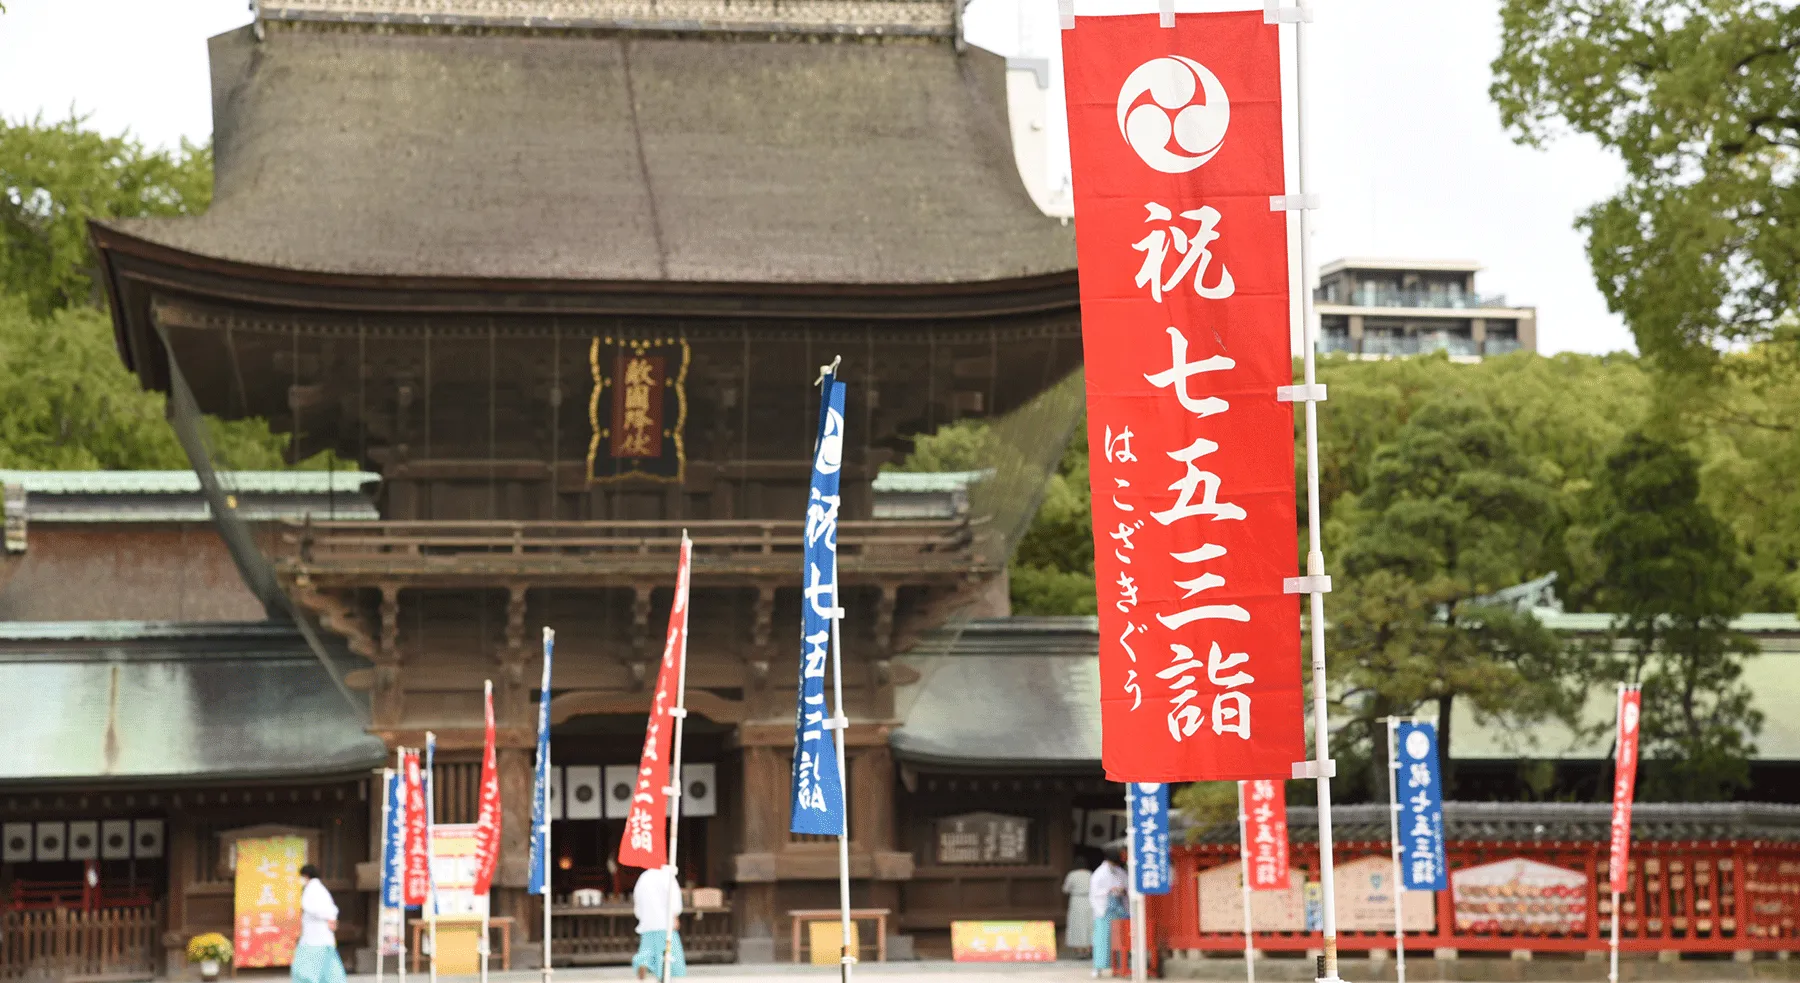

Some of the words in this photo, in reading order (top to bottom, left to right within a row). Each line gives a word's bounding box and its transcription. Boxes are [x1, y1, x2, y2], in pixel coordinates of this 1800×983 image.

[1104, 425, 1149, 713] はこざきぐう
[1132, 202, 1253, 743] 祝七五三詣
